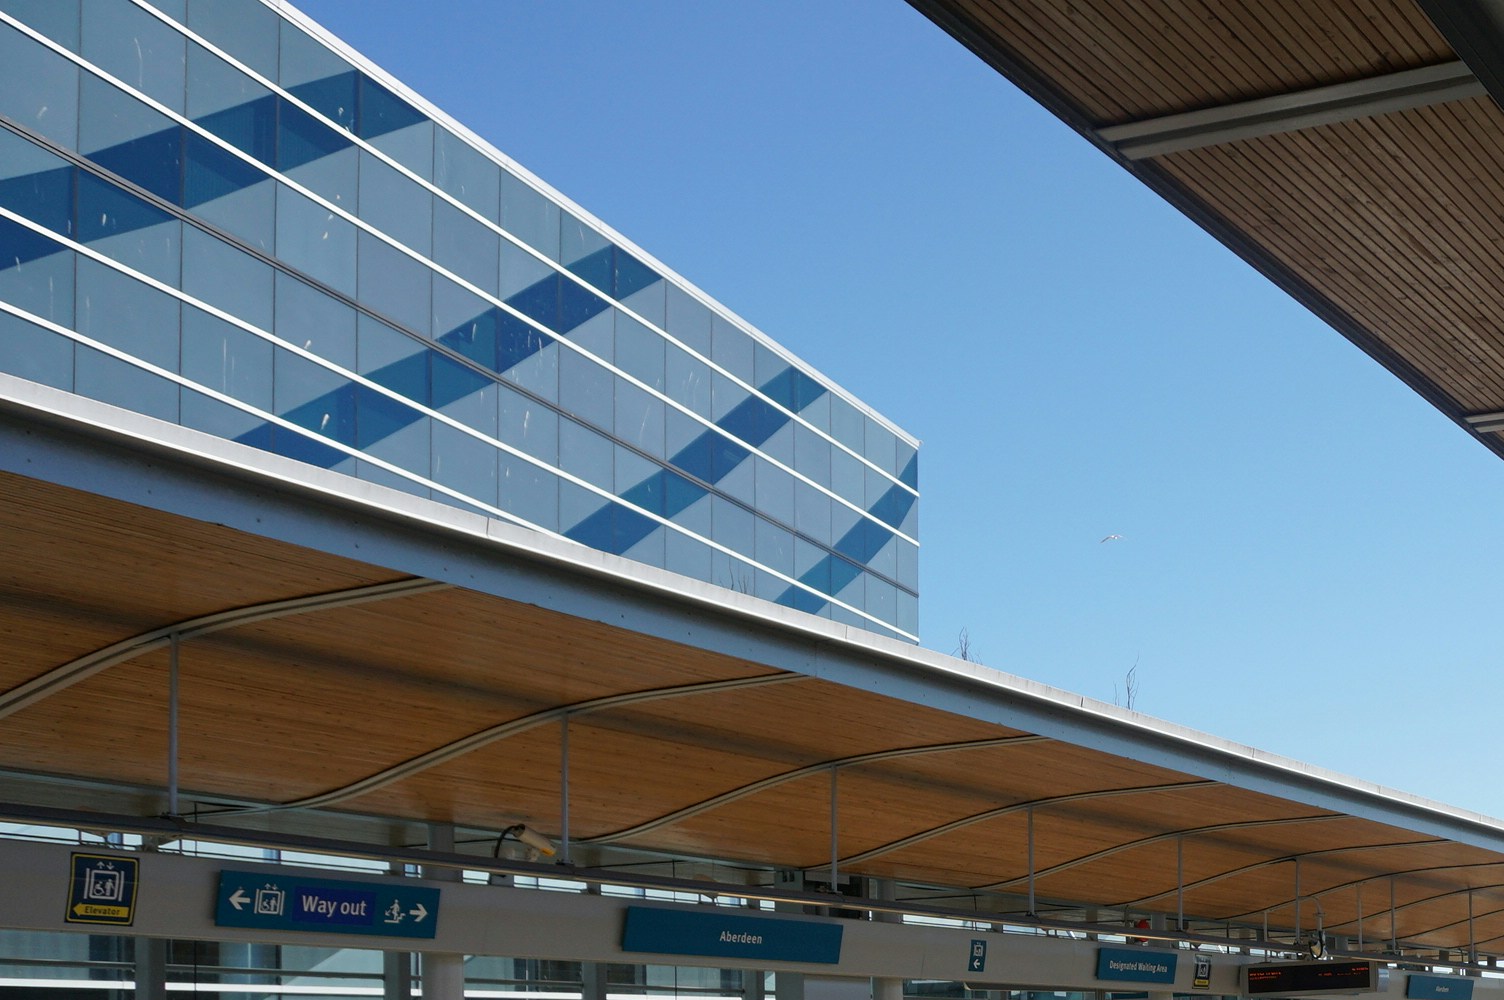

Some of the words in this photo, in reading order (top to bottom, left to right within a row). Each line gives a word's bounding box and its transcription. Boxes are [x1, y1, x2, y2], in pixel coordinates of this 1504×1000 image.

[84, 905, 120, 916] Elevator
[302, 894, 336, 918] Way
[340, 900, 367, 916] out
[719, 930, 763, 945] Aberdeen
[1109, 960, 1137, 972] Designated
[1138, 962, 1155, 974] Waiting
[1156, 964, 1168, 973] Area
